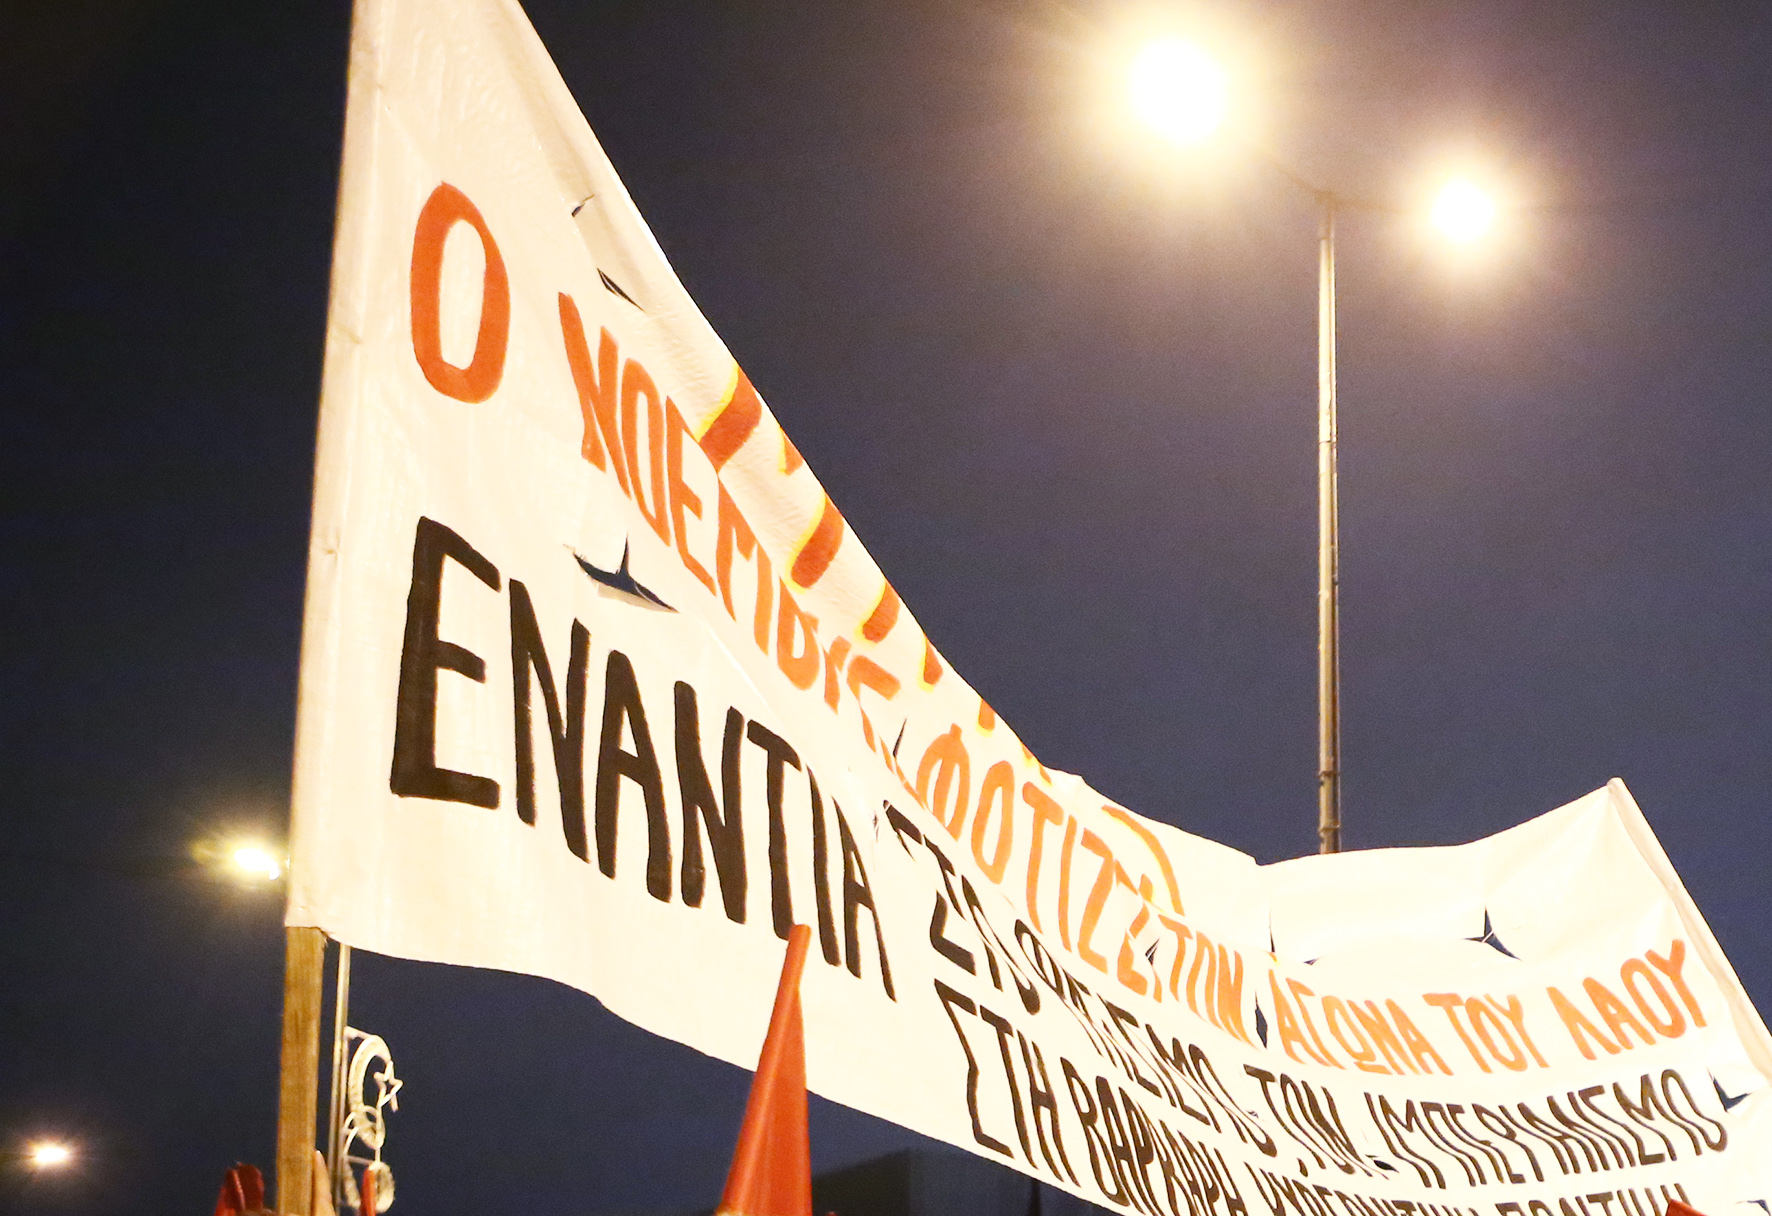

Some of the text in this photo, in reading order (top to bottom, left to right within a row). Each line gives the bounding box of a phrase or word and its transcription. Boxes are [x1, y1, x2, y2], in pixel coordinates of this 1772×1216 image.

[390, 515, 898, 1004] ΕΝΑΝΤΙΑ
[410, 181, 511, 403] Ο
[1157, 913, 1262, 1052] ΤΟΝ
[1421, 992, 1550, 1073] ΤΟΥ
[1546, 938, 1708, 1061] ΛΑΟΥ
[933, 977, 1083, 1189] ΣΤΗ
